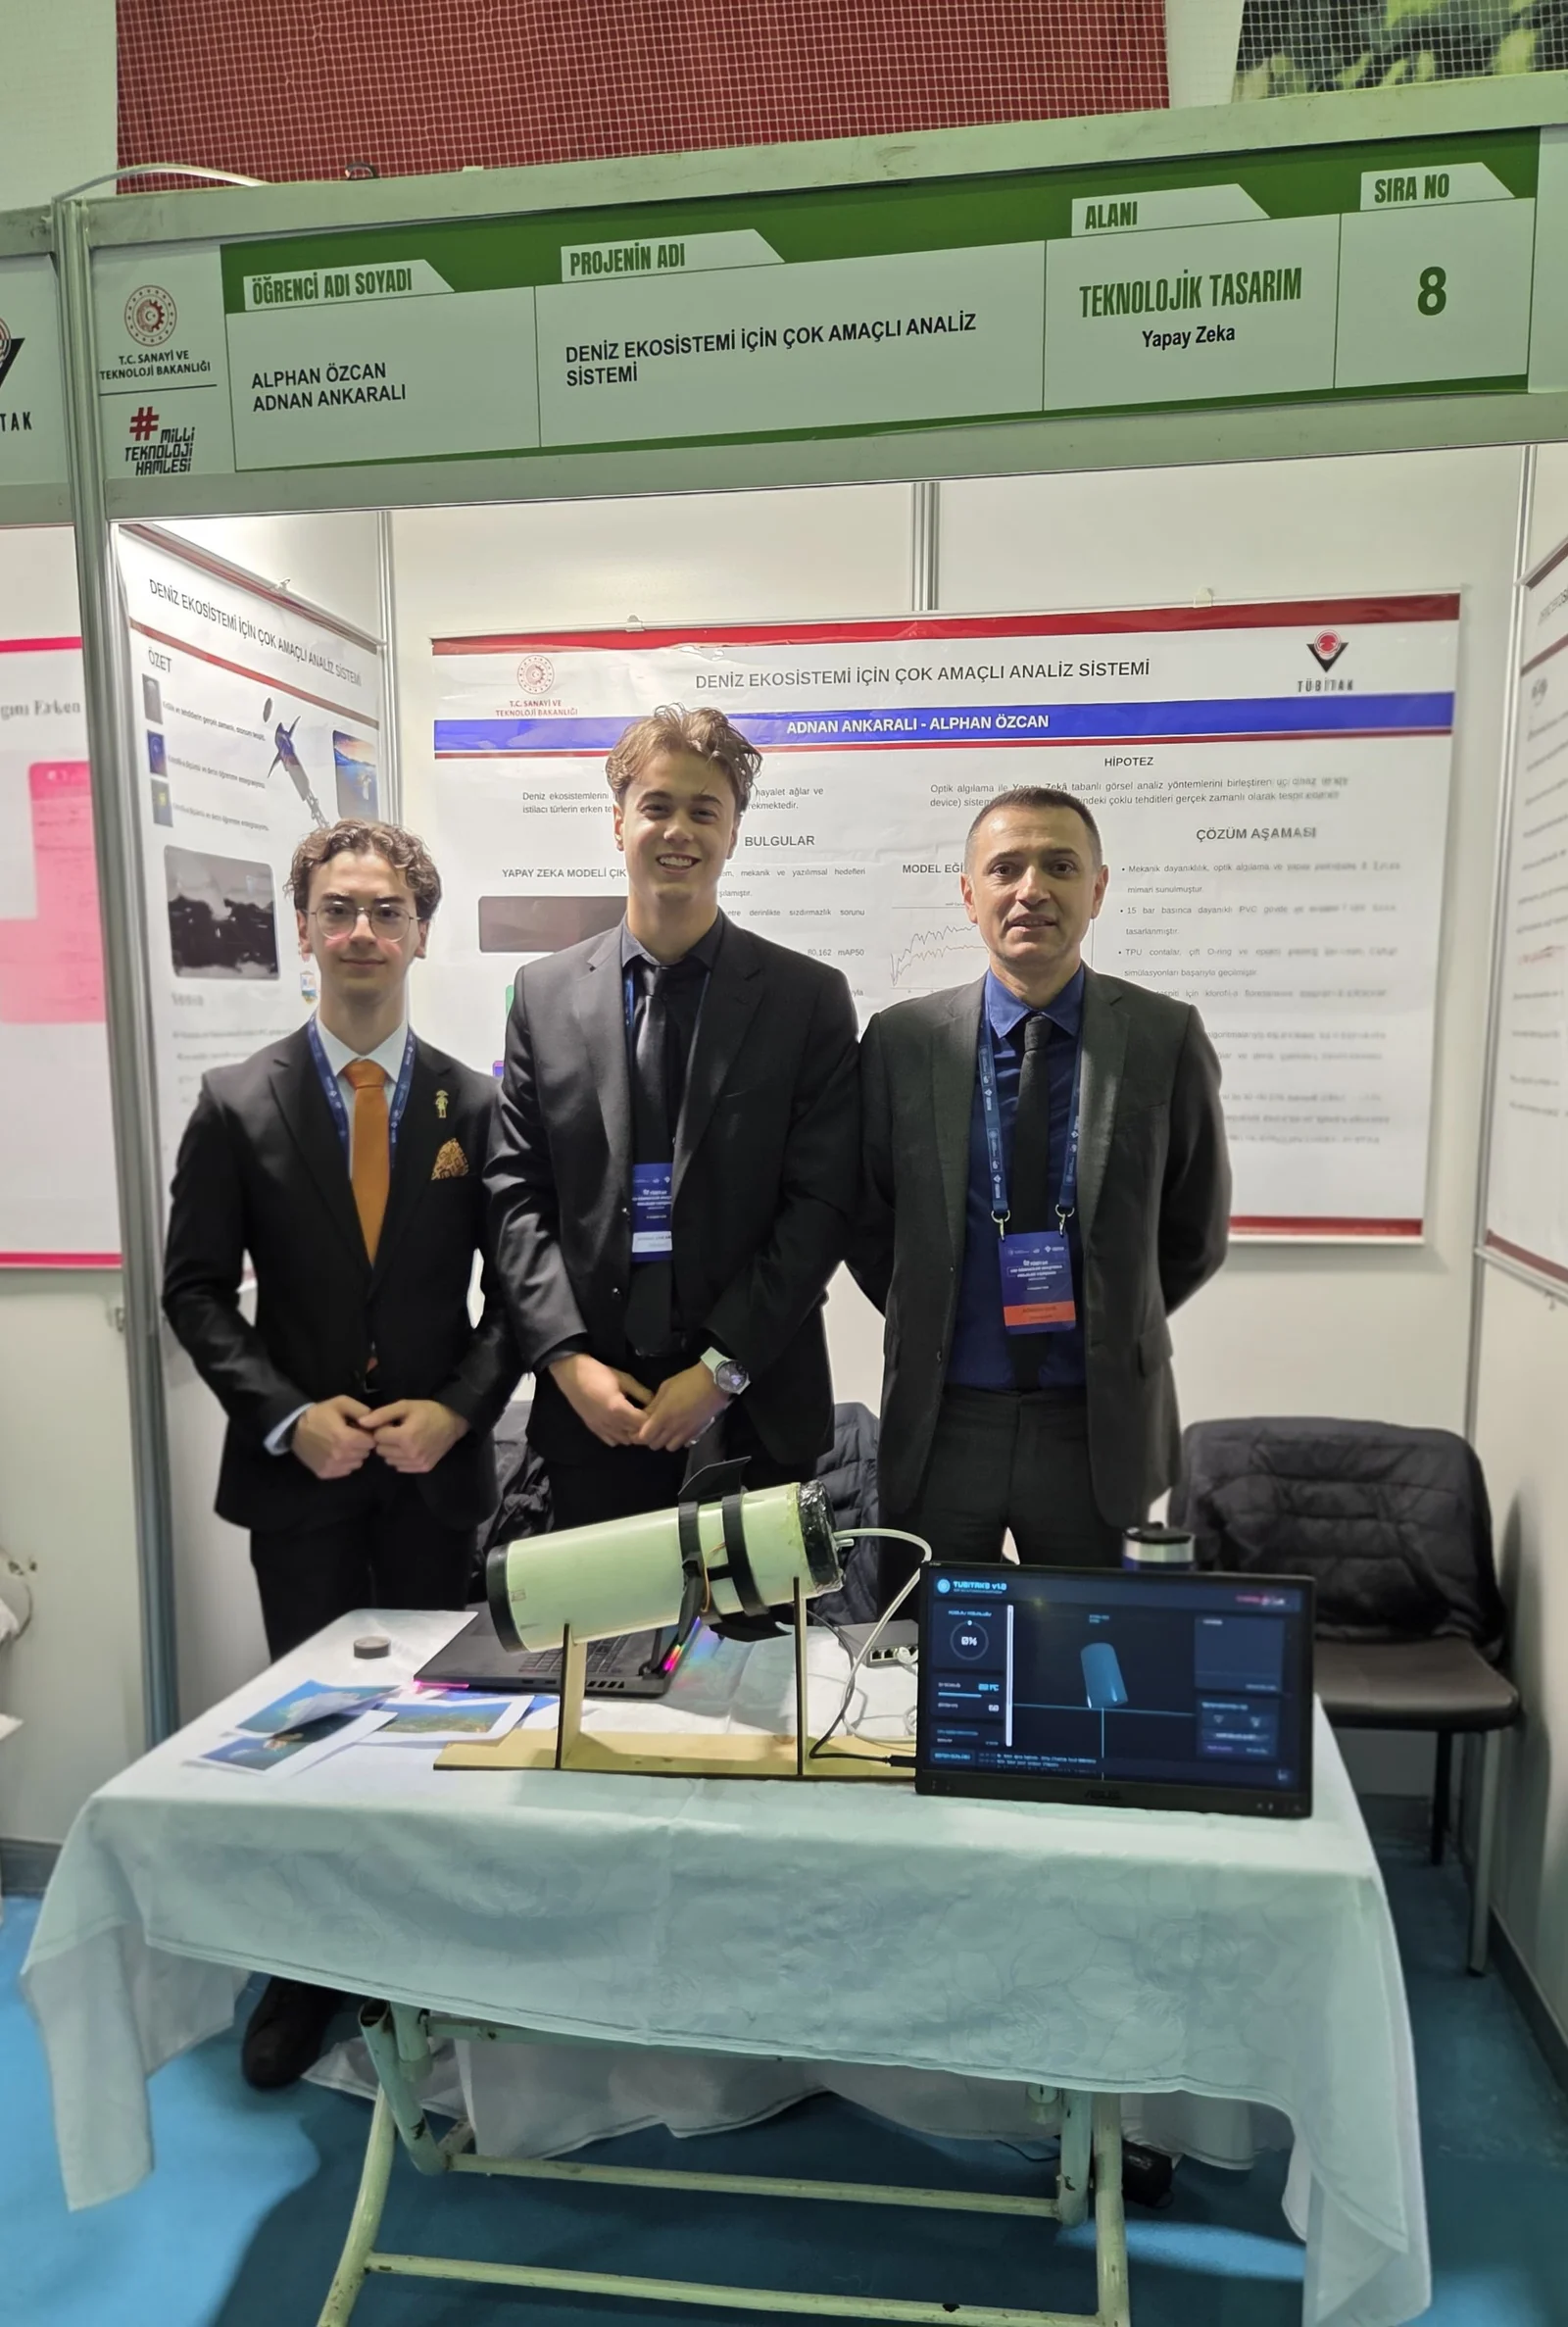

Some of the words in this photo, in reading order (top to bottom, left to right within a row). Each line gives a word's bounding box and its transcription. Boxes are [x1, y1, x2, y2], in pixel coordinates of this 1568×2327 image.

[1374, 175, 1417, 203] SIRA
[1424, 173, 1450, 200] NO
[1084, 201, 1138, 229] ALANI
[569, 242, 652, 276] PROJENİN
[657, 243, 685, 269] ADI
[252, 272, 318, 305] ÖĞRENCİ
[323, 273, 350, 298] ADI
[355, 268, 413, 295] SOYADI
[1079, 269, 1202, 318] TEKNOLOJİK
[1209, 267, 1302, 307] TASARIM
[1417, 266, 1446, 316] 8
[565, 340, 619, 363] DENİZ
[624, 328, 735, 358] EKOSİSTEMİ
[741, 327, 777, 352] İÇİN
[783, 325, 824, 350] ÇOK
[828, 320, 902, 343] AMAÇLI
[906, 310, 976, 335] ANALİZ
[1142, 329, 1192, 351] Yapay
[1196, 324, 1235, 343] Zeka
[119, 354, 136, 366] T.C.
[137, 349, 174, 364] SANAYİ
[175, 350, 189, 361] VE
[99, 364, 154, 380] TEKNOLOJİ
[157, 360, 211, 374] BAKANLIĞI
[251, 368, 320, 389] ALPHAN
[326, 362, 386, 383] ÖZCAN
[566, 362, 638, 386] SİSTEMİ
[253, 392, 313, 413] ADNAN
[318, 383, 406, 407] ANKARALI
[149, 578, 179, 606] DENİZ
[181, 593, 237, 631] EKOSİSTEMİ
[238, 616, 257, 639] İÇİN
[258, 628, 276, 648] ÇOK
[148, 646, 172, 672] ÖZET
[695, 672, 745, 689] DENİZ
[749, 666, 852, 687] EKOSİSTEMİ
[856, 664, 890, 687] İÇİN
[895, 666, 933, 684] ÇOK
[937, 664, 1004, 684] AMAÇLI
[1008, 660, 1074, 679] ANALİZ
[1078, 658, 1150, 677] SİSTEMİ
[786, 718, 839, 734] ADNAN
[841, 718, 918, 733] ANKARALI
[929, 715, 992, 731] ALPHAN
[995, 714, 1050, 729] ÖZCAN
[1103, 756, 1154, 767] HİPOTEZ
[522, 792, 546, 801] Deniz
[788, 787, 809, 798] ağlar
[930, 784, 954, 796] Optik
[956, 783, 994, 795] algılama
[998, 783, 1008, 792] ile
[1071, 782, 1102, 791] tabanlı
[1105, 781, 1133, 792] görsel
[1137, 781, 1163, 790] analiz
[1167, 779, 1223, 791] yöntemlerini
[1227, 777, 1272, 788] birleştiren
[522, 805, 548, 814] istilacı
[550, 805, 578, 814] türlerin
[930, 798, 961, 808] device)
[963, 798, 992, 807] sistem
[1079, 795, 1106, 805] indeki
[1109, 794, 1132, 806] çoklu
[1135, 794, 1173, 803] tehditleri
[1176, 793, 1206, 804] gerçek
[1209, 792, 1245, 802] zamanlı
[1248, 792, 1276, 801] olarak
[744, 835, 815, 847] BULGULAR
[1196, 827, 1248, 842] ÇÖZÜM
[502, 868, 534, 878] YAPAY
[536, 868, 564, 878] ZEKA
[566, 866, 607, 878] MODELİ
[609, 867, 627, 880] ÇIK
[902, 864, 942, 873] MODEL
[945, 861, 963, 873] EĞİ
[1128, 865, 1160, 873] Mekanik
